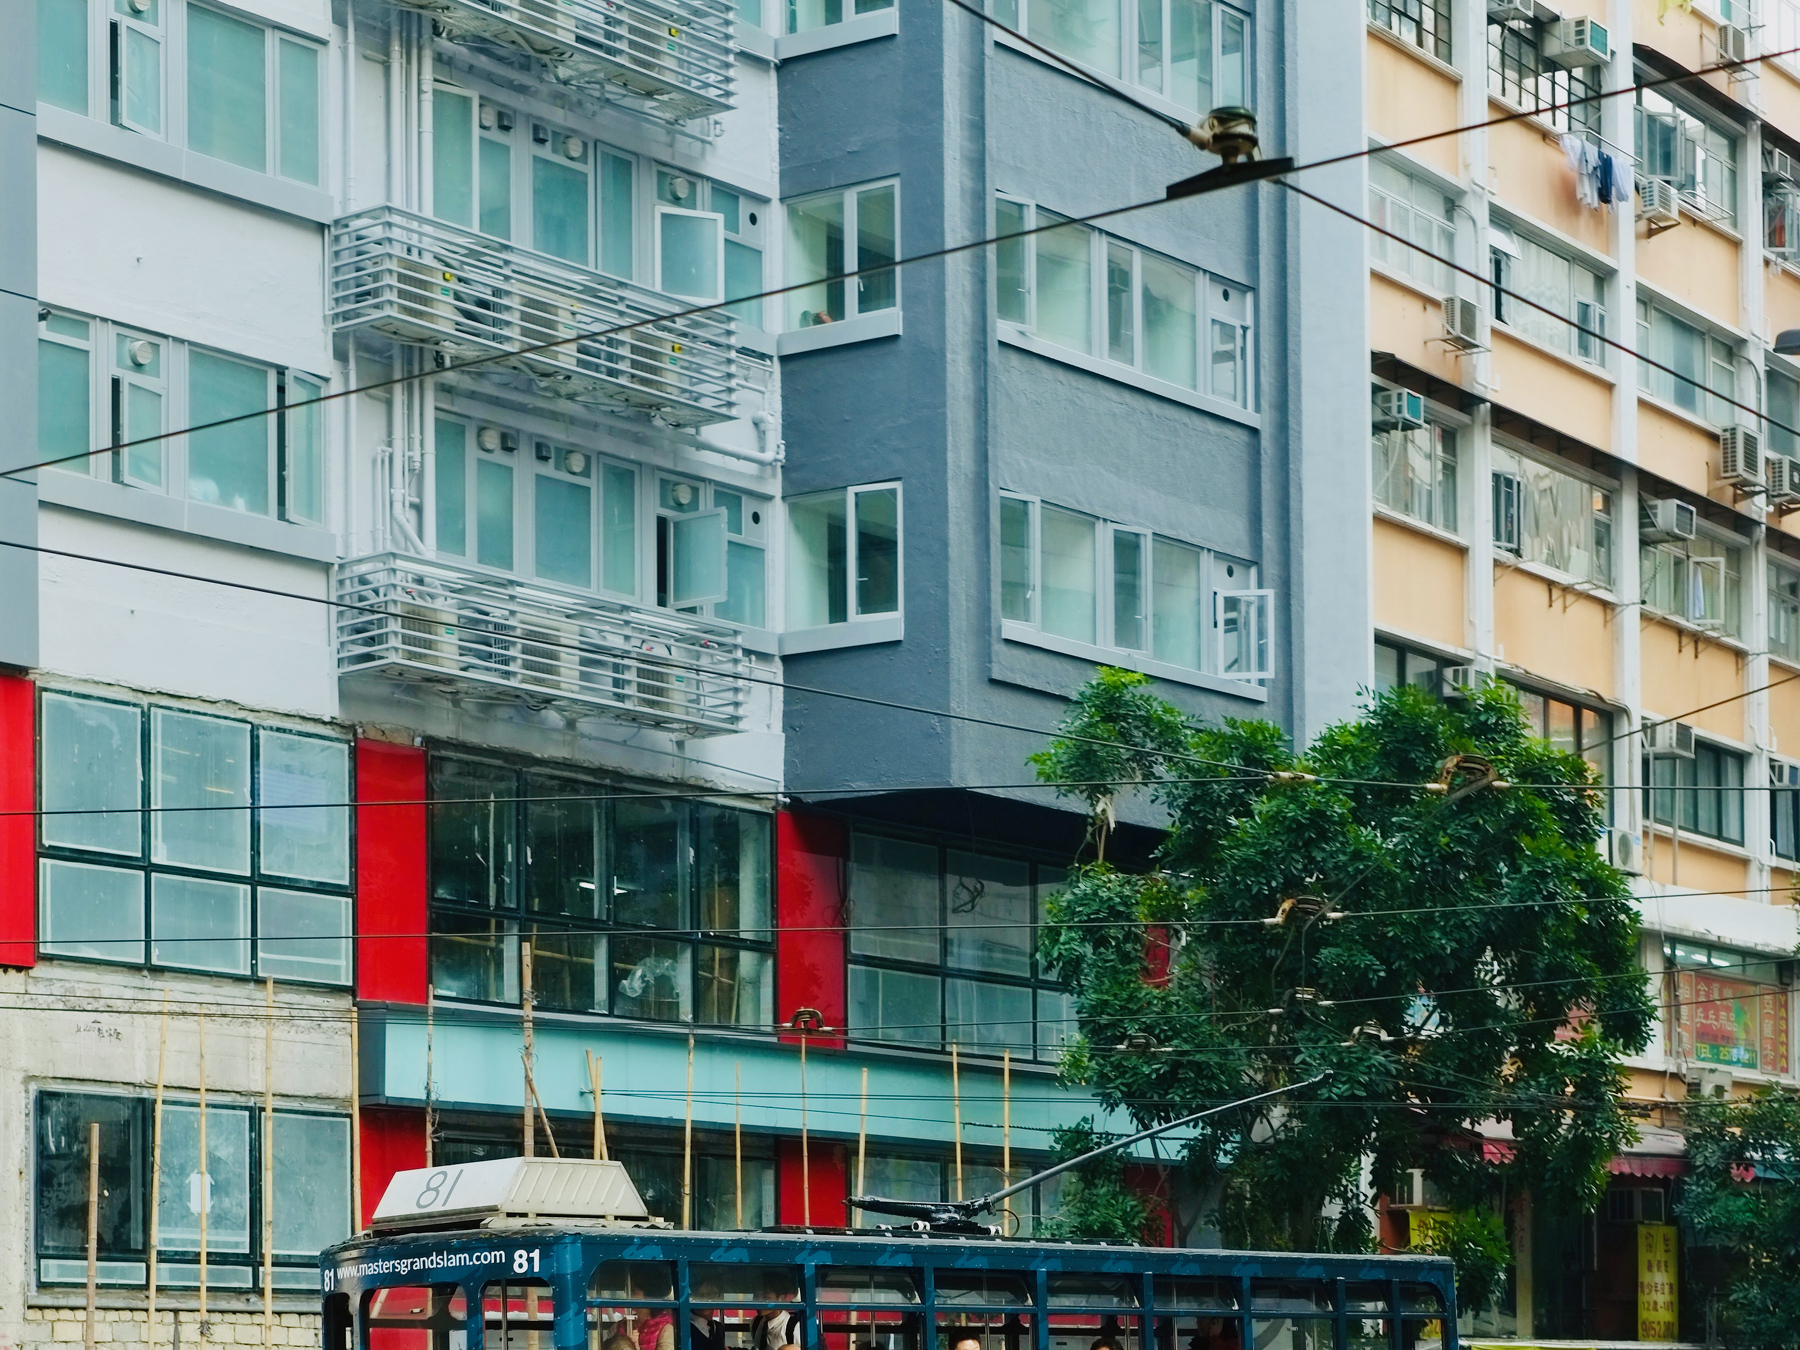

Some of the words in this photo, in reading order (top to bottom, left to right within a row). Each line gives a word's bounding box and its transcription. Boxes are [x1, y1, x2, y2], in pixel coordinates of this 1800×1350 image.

[1695, 1008, 1738, 1031] 乒乓用品
[416, 1169, 464, 1209] 81
[324, 1268, 335, 1292] 81
[336, 1250, 506, 1280] www.mastersgrandslam.com
[513, 1249, 540, 1273] 81
